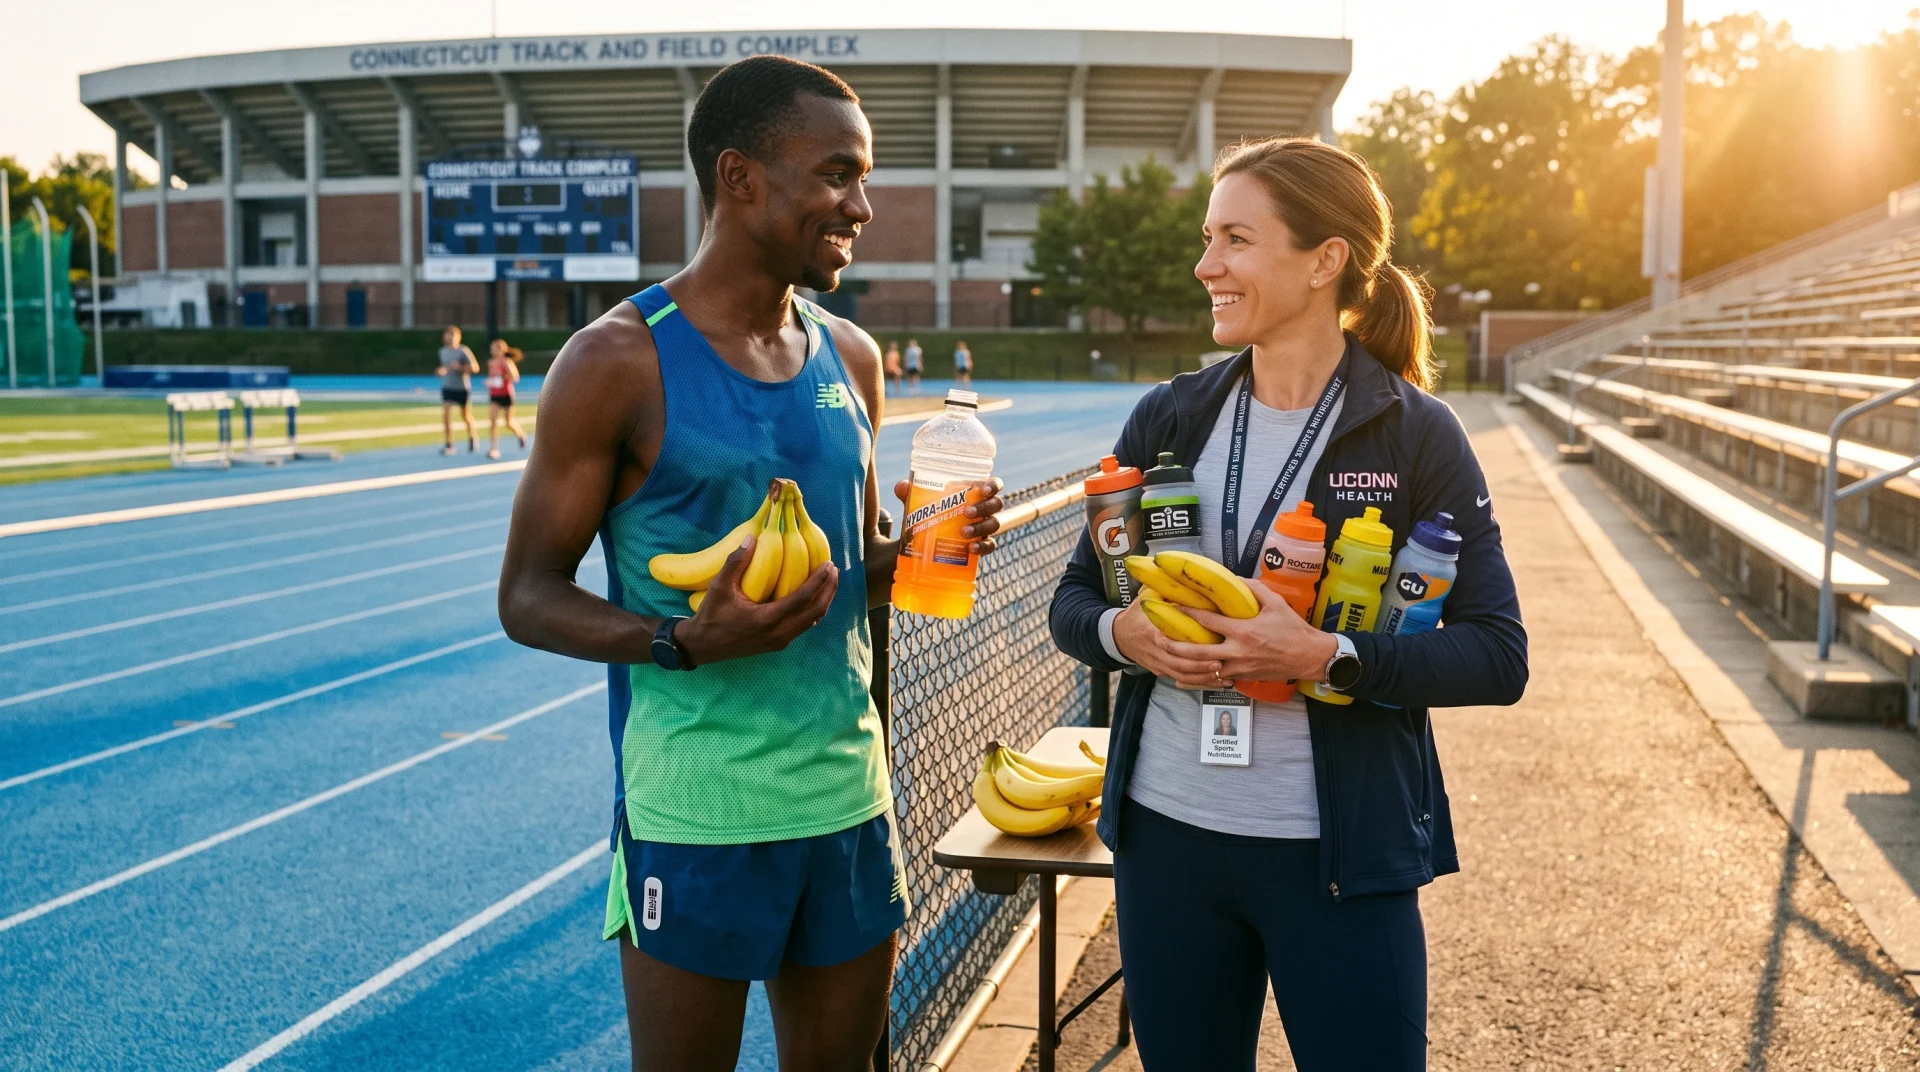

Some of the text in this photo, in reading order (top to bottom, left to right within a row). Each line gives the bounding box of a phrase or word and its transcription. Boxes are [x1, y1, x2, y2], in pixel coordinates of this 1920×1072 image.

[350, 35, 859, 71] CONNECTICUT TRACK AND FIELD COMPLEX
[520, 160, 564, 177] TRACK
[565, 159, 632, 176] COMPLEX
[1329, 472, 1398, 489] UCONN
[1336, 490, 1392, 502] HEALTH
[906, 490, 966, 529] HYDRA-MAX
[1097, 516, 1131, 556] G
[1265, 553, 1282, 566] GU
[1287, 558, 1322, 570] ROCTANE
[1400, 578, 1425, 595] GU
[1207, 751, 1242, 759] Nutritionist
